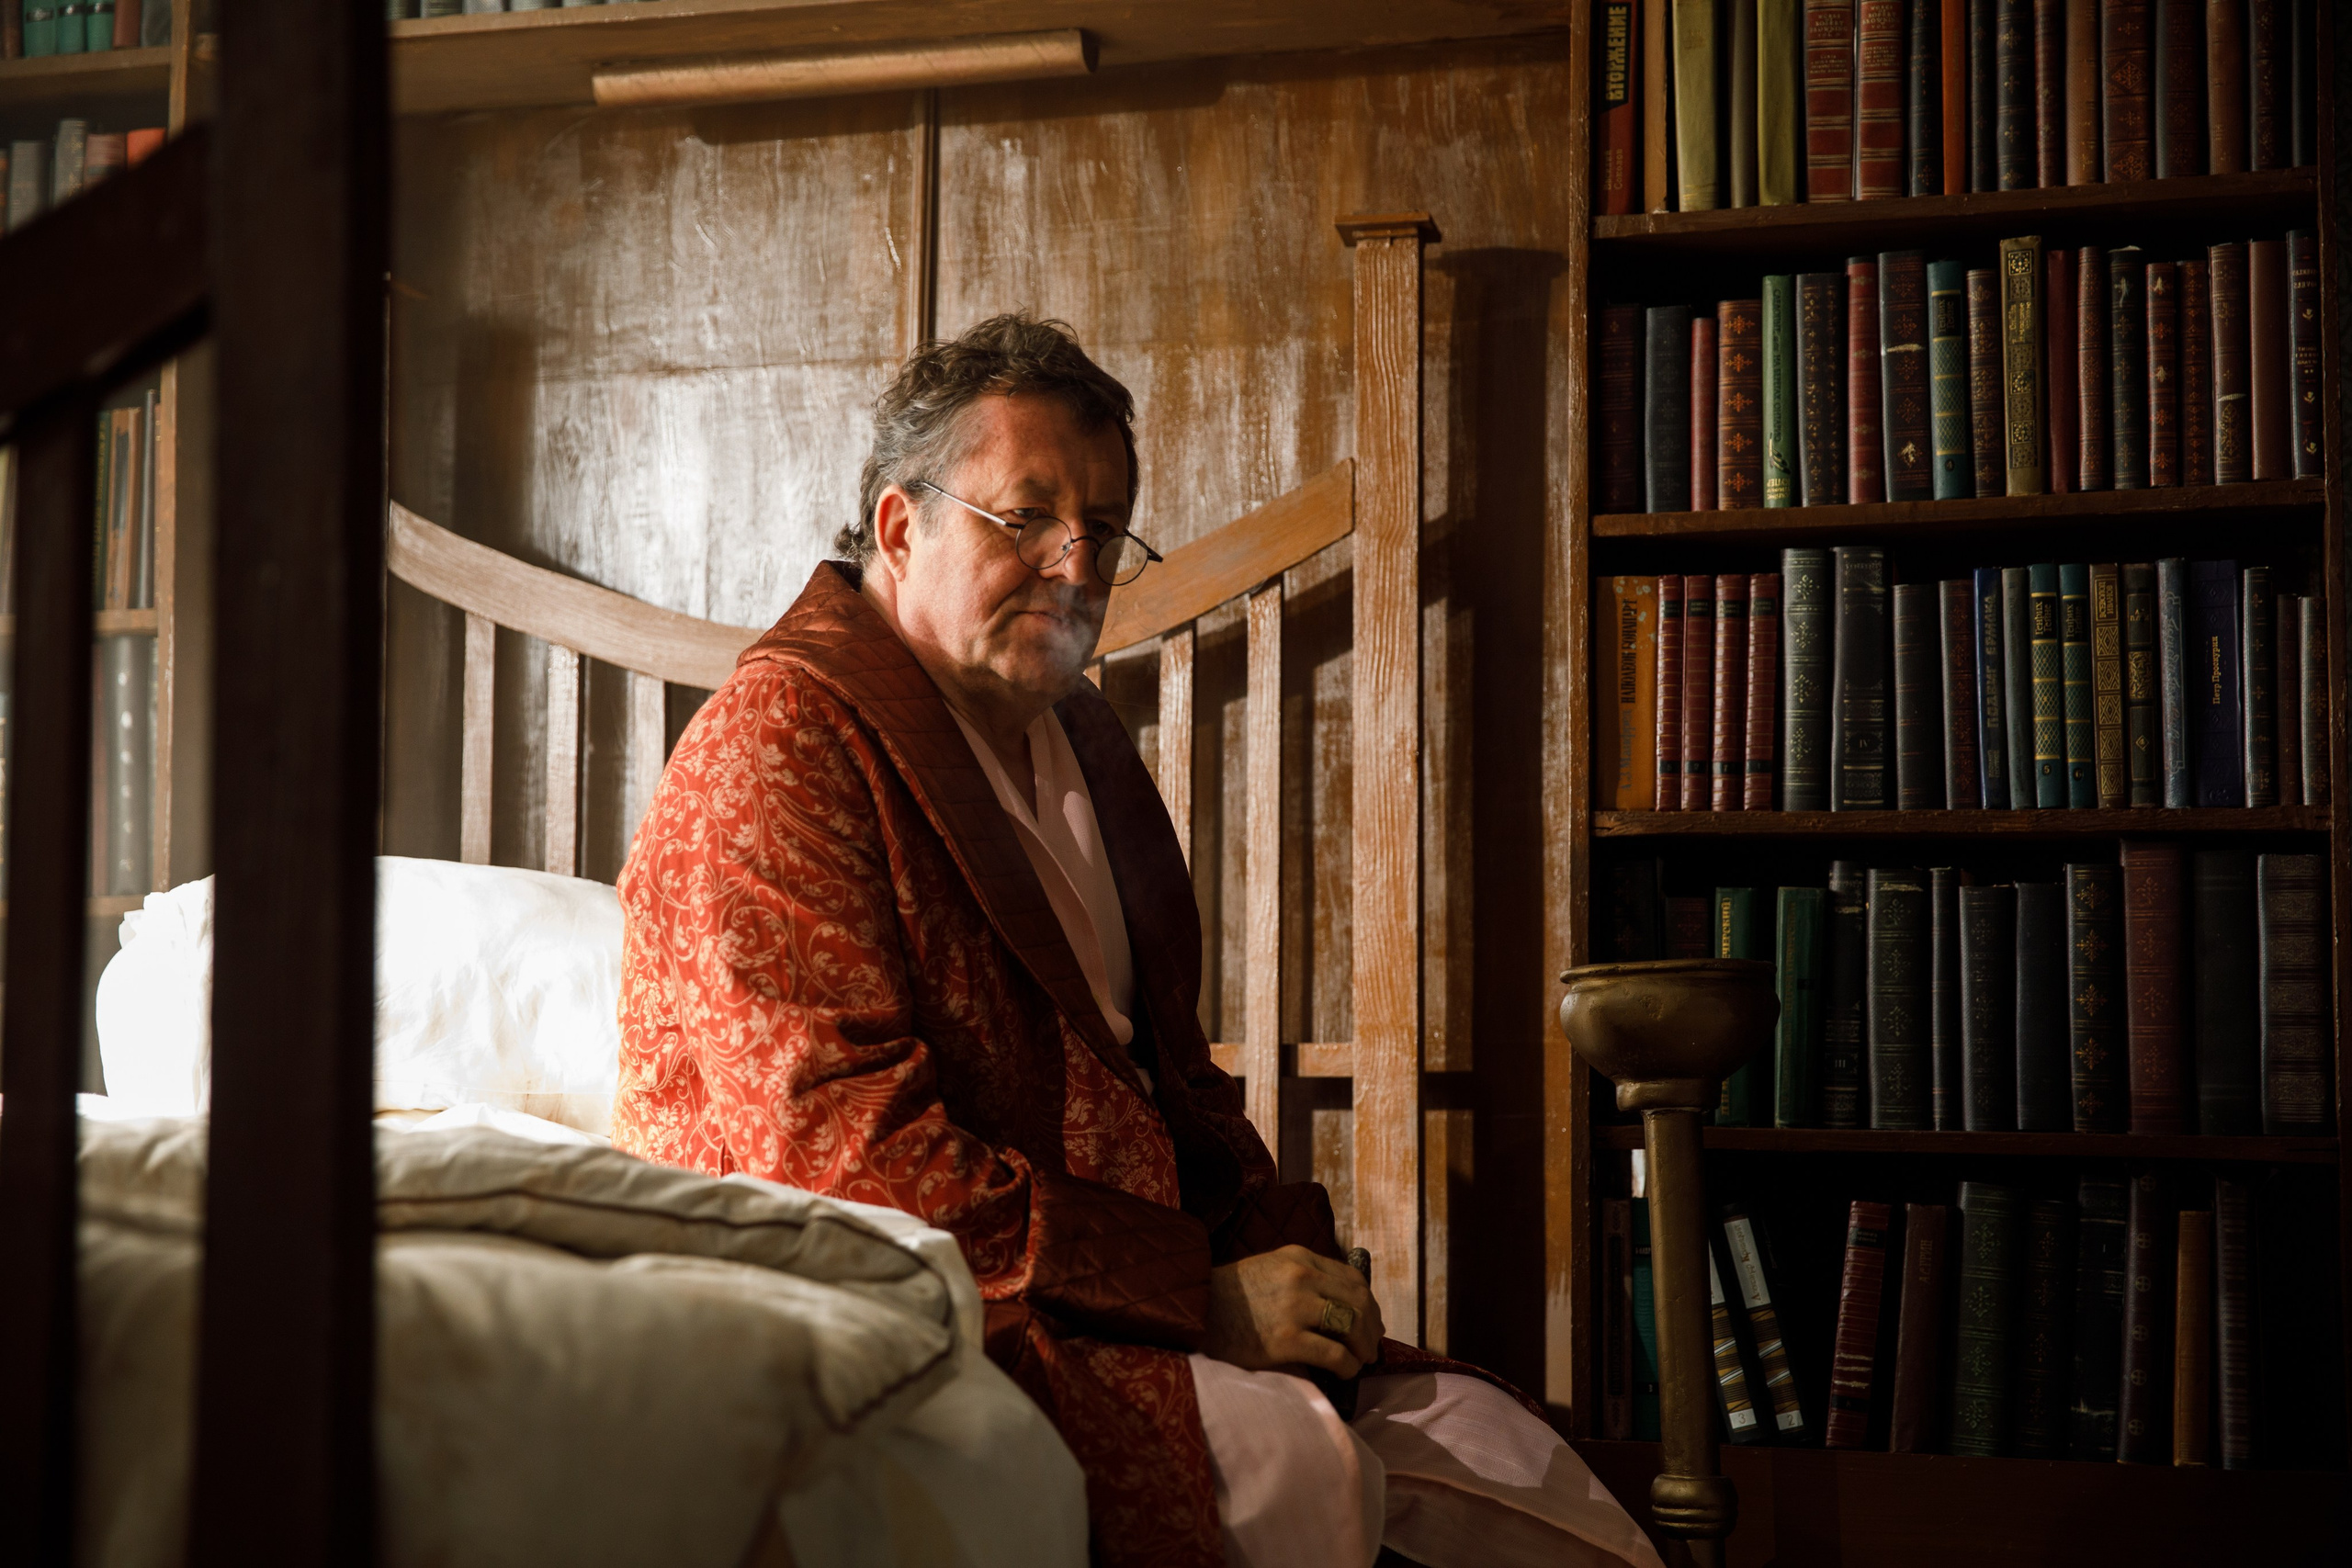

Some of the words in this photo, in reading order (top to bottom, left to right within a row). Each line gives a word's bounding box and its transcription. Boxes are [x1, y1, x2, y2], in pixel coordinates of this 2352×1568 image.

[1605, 5, 1628, 101] ВТОРЖЕНИЕ
[1613, 148, 1623, 190] Соколов
[1773, 355, 1781, 367] НА
[1773, 401, 1781, 443] ОНТАРИО
[2098, 581, 2107, 618] ВСЕВОЛОД
[2106, 584, 2114, 615] ИВАНОВ
[1621, 598, 1637, 650] БОНАПАРТ
[1984, 593, 1997, 656] ЕРМАКА
[2033, 601, 2043, 636] Генрих
[2065, 604, 2075, 638] Генрих
[1621, 651, 1636, 704] НАПОЛЕОН
[2211, 636, 2222, 683] Проскурин
[1985, 664, 1999, 728] ПОДВИГ
[2211, 682, 2222, 705] Петр
[2043, 763, 2052, 775] 5
[2075, 770, 2082, 781] 6
[1721, 897, 1731, 958] ЕЧЕРСКИЙ)
[1834, 1059, 1847, 1068] III
[1737, 1412, 1747, 1425] 3
[1786, 1414, 1796, 1426] 2
